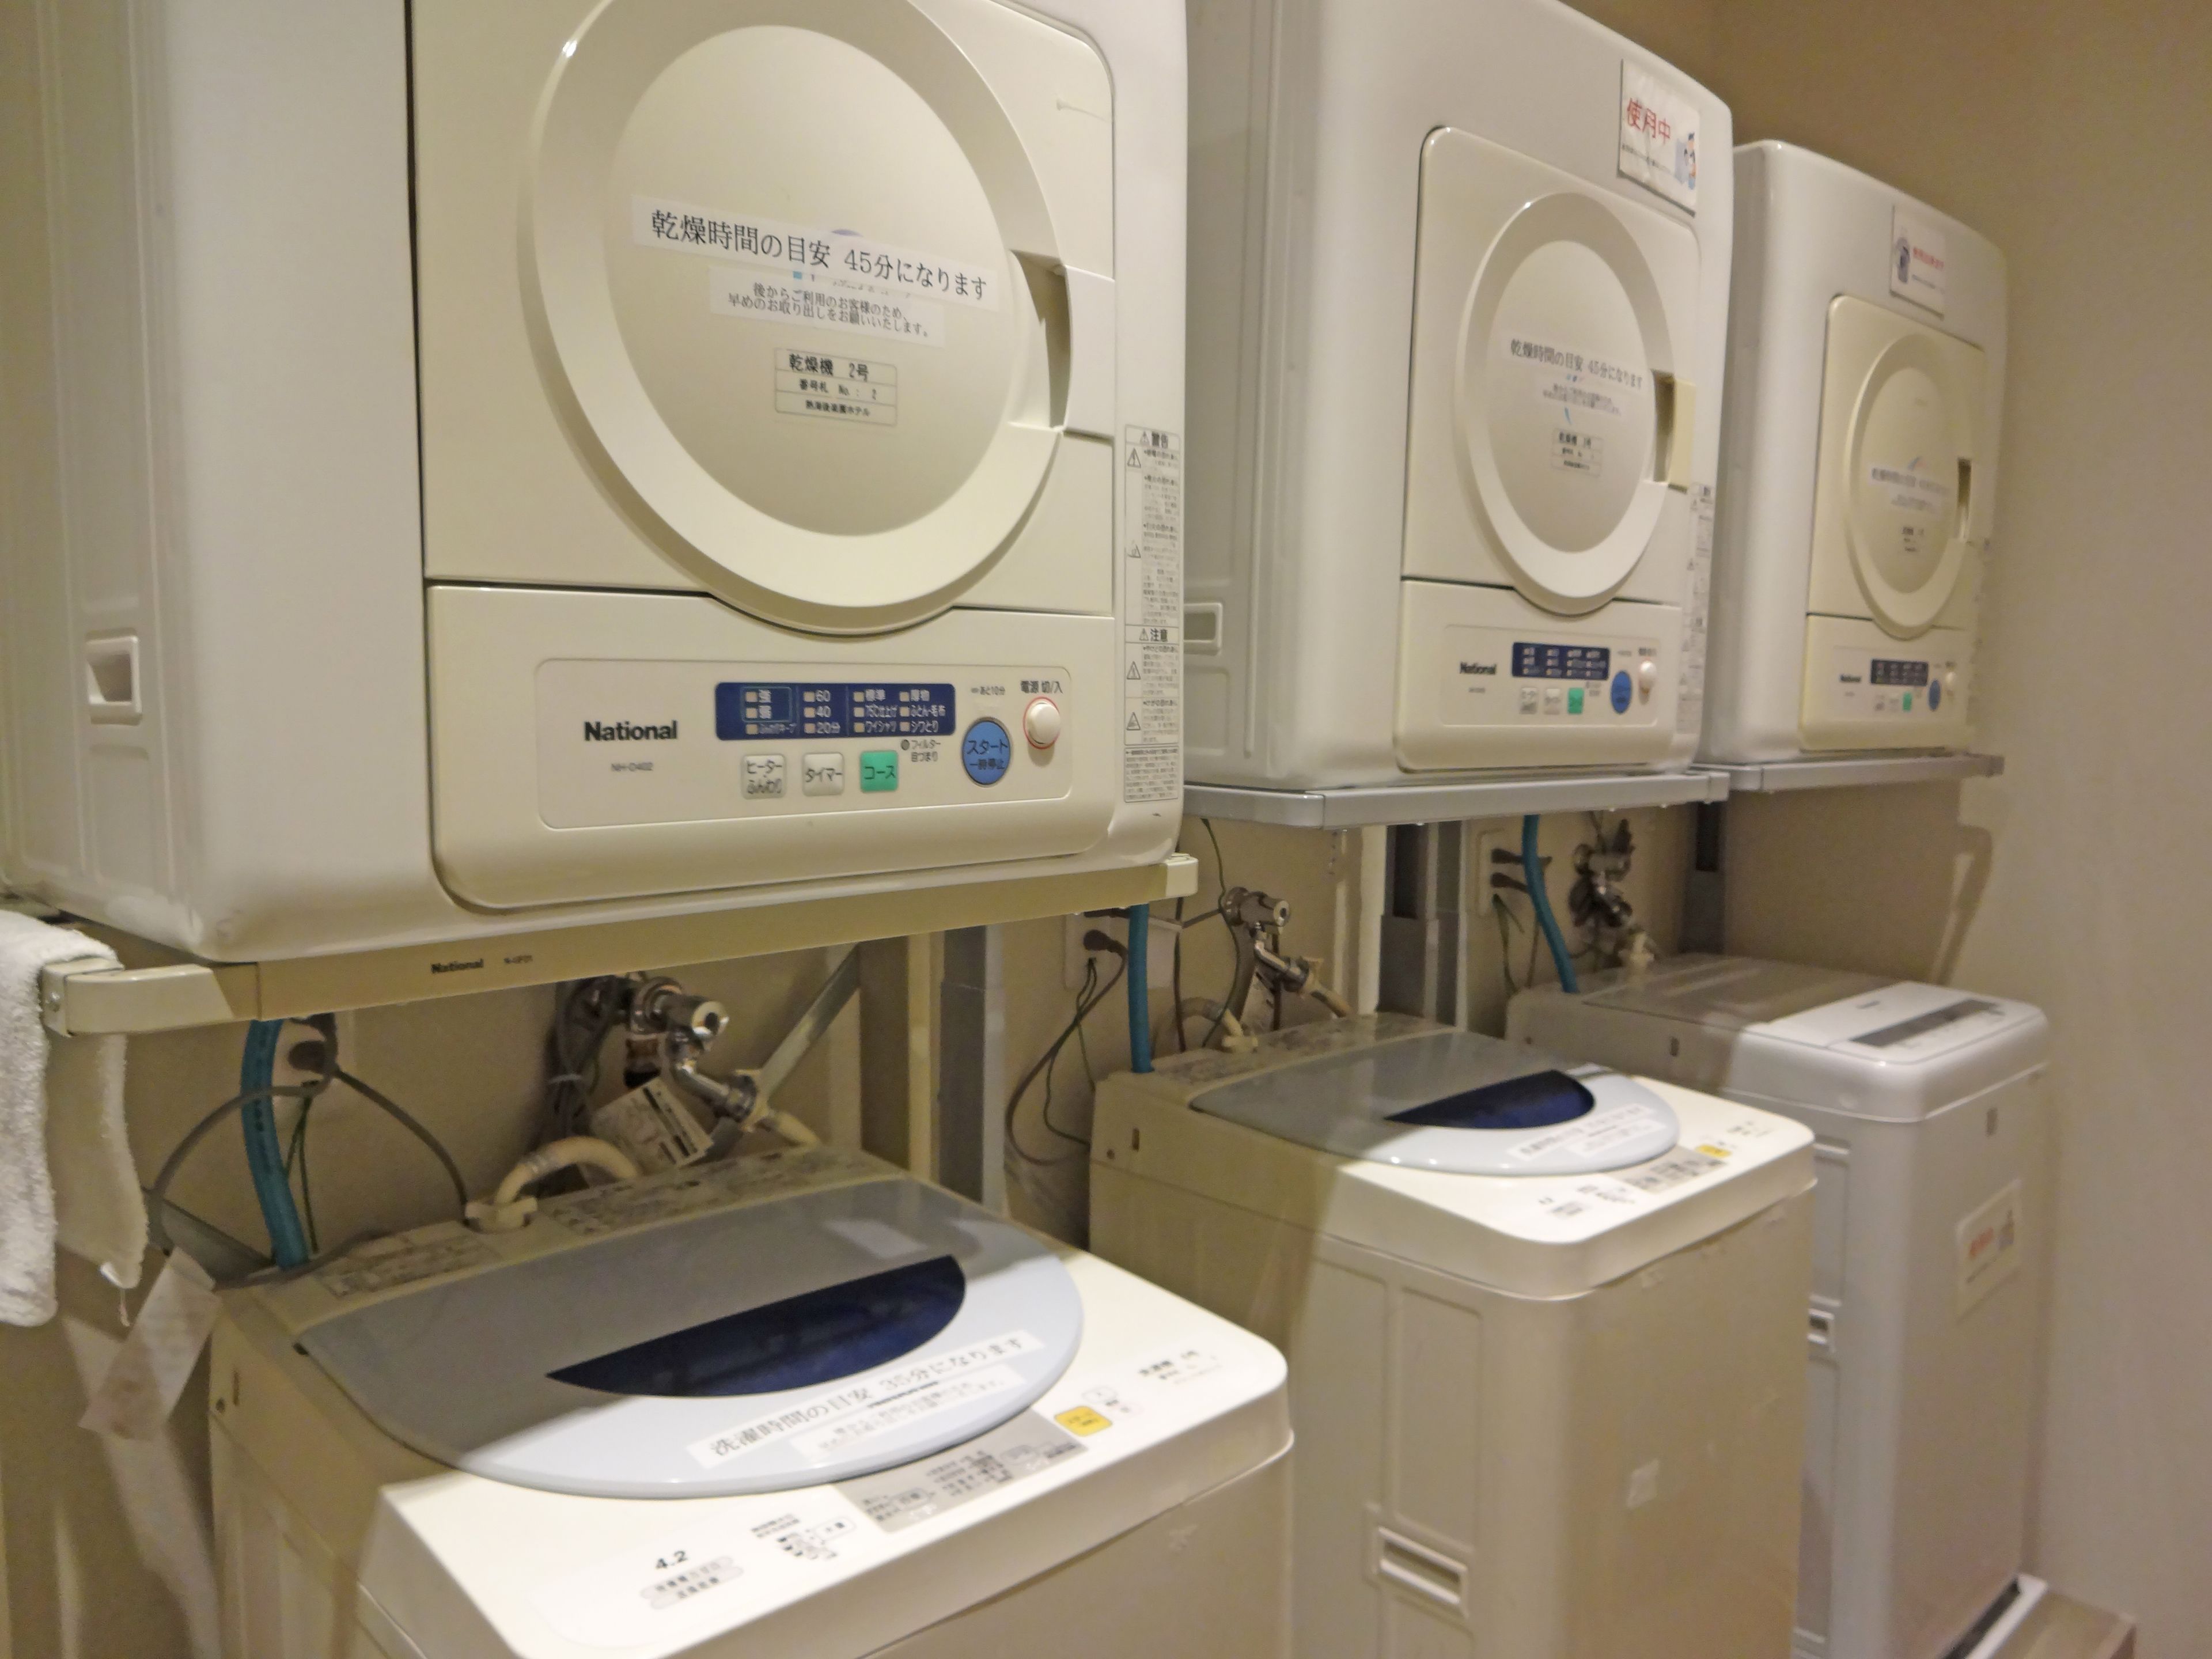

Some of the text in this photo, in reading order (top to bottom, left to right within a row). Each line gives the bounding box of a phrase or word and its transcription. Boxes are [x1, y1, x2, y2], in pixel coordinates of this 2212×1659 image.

[1627, 97, 1670, 145] 使用中
[652, 210, 986, 300] 乾燥時間の目安 45分になります
[753, 282, 908, 321] 後からご利用のお客様のため、
[729, 293, 928, 337] 早めのお取り出しをお願いいたします。
[1510, 338, 1583, 372] 乾燥時間の目安
[789, 354, 869, 382] 乾燥機 2号
[800, 378, 829, 393] 番号札
[1150, 628, 1168, 642] 注意
[1021, 680, 1039, 694] 電源
[816, 690, 831, 702] 60
[816, 706, 831, 718] 40
[584, 719, 678, 741] National
[816, 721, 841, 734] 20分
[967, 739, 1009, 755] スタート
[747, 759, 783, 775] ヒーター
[864, 765, 896, 779] コース
[969, 758, 1005, 771] 一時停止
[806, 767, 843, 783] タイマー
[747, 778, 782, 794] ふんわり
[431, 958, 484, 974] National
[656, 1550, 687, 1569] 4.2
